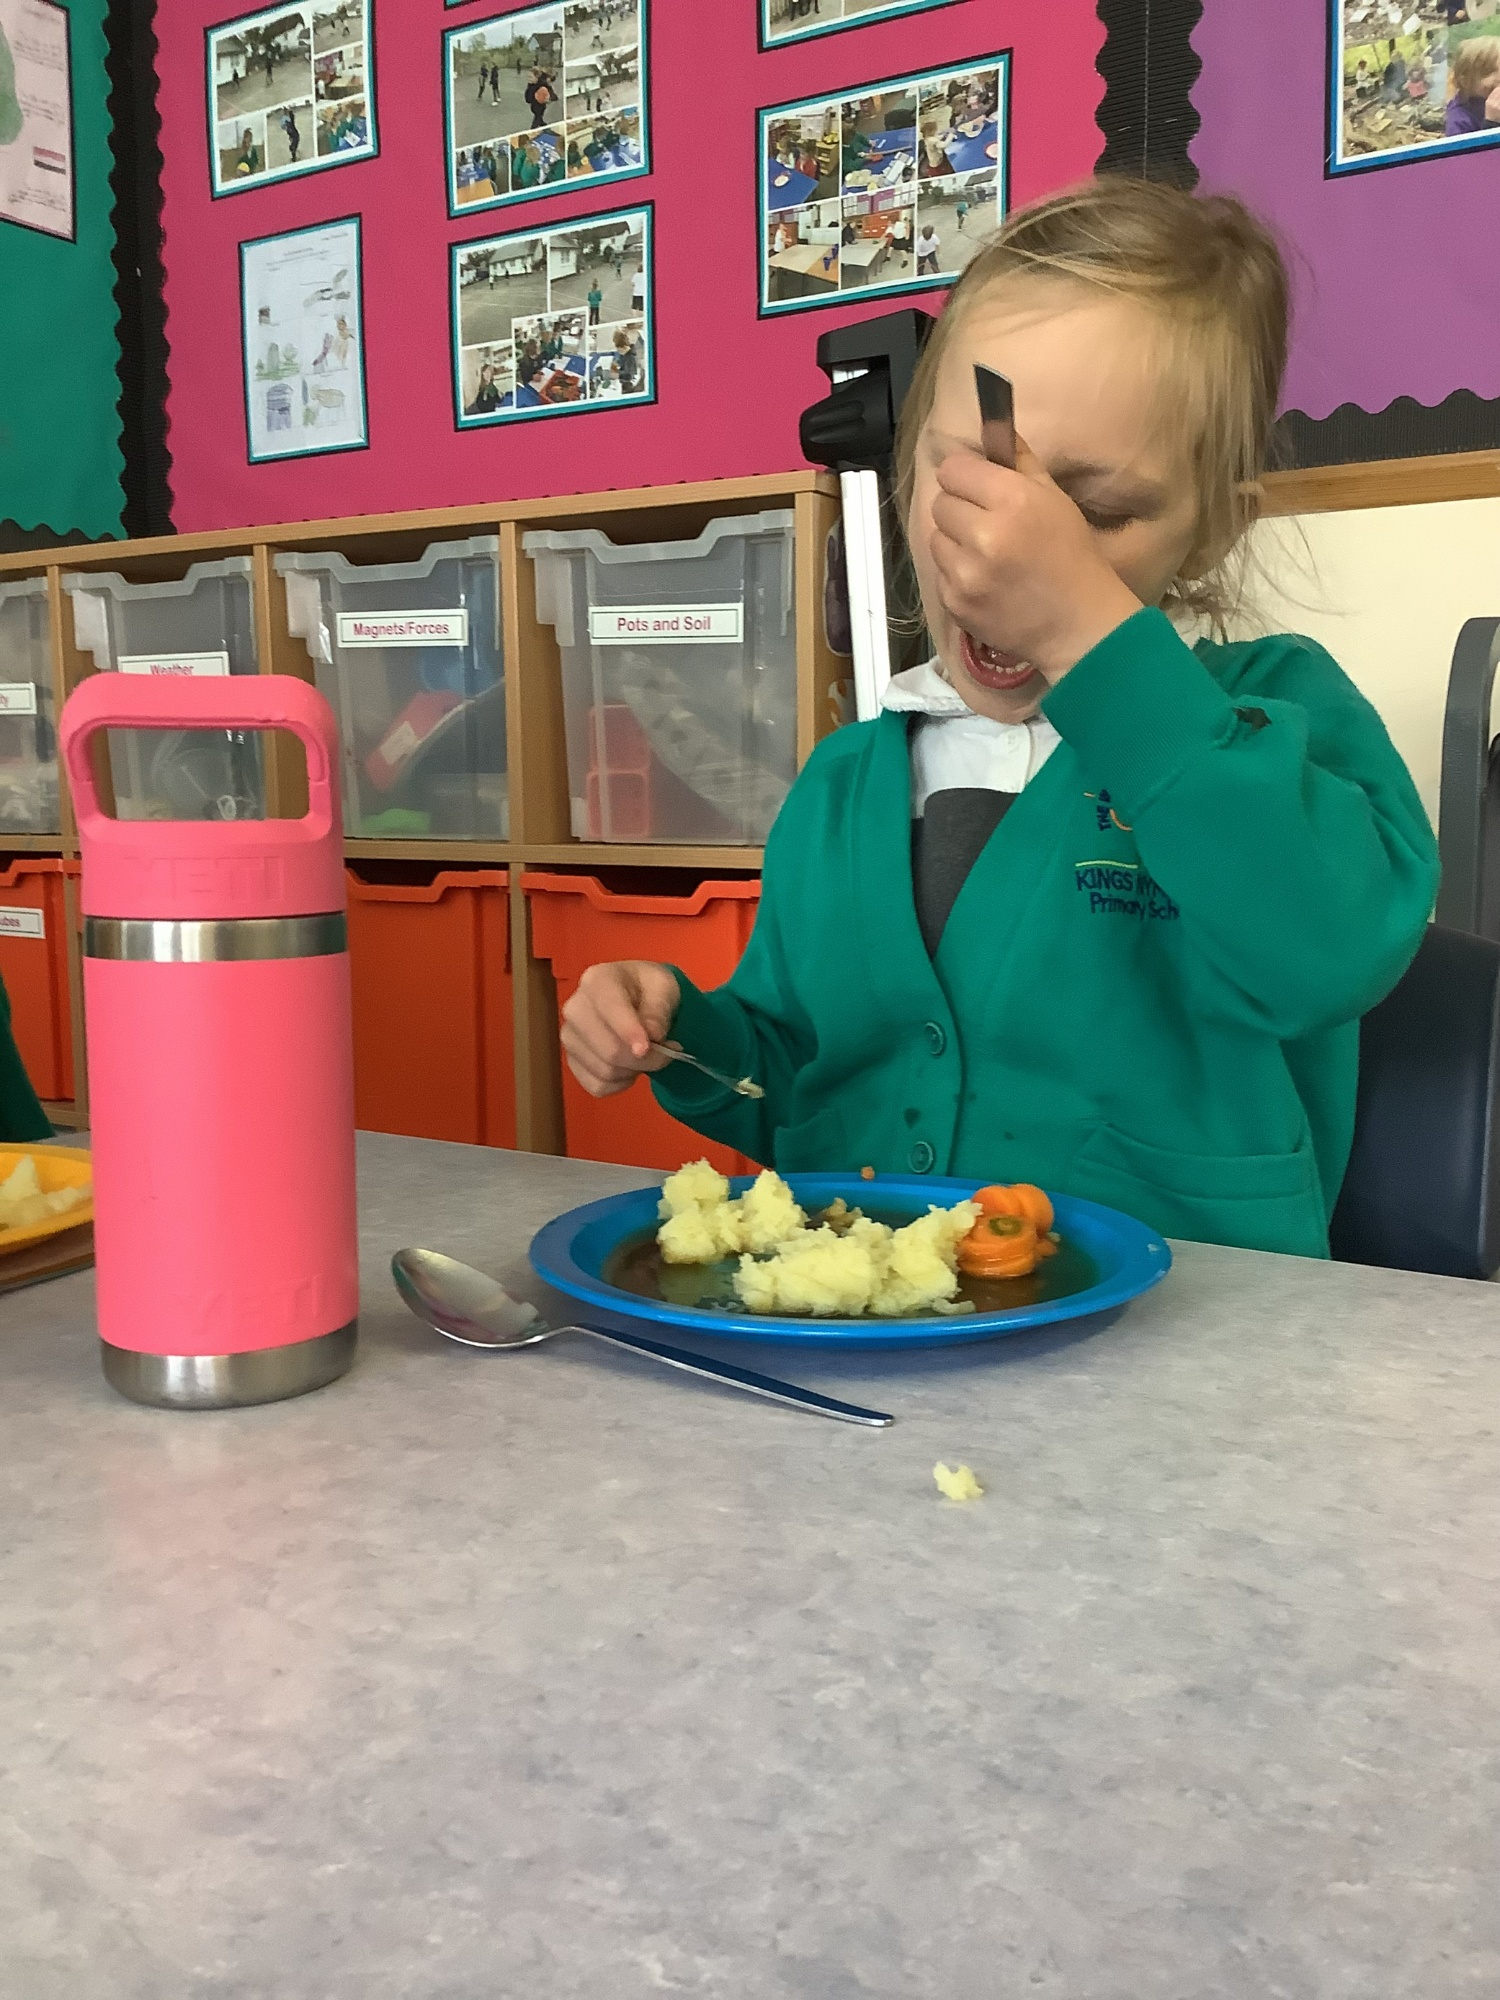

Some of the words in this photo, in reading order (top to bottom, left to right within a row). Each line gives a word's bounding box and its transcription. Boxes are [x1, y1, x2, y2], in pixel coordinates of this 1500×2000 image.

[353, 621, 450, 638] Magnets/Forces
[617, 617, 649, 631] Pots
[653, 616, 679, 631] and
[684, 615, 711, 630] Soil
[150, 664, 194, 676] Weather
[121, 856, 284, 901] YETI
[1075, 868, 1133, 891] KINGS
[1090, 891, 1145, 919] Primary
